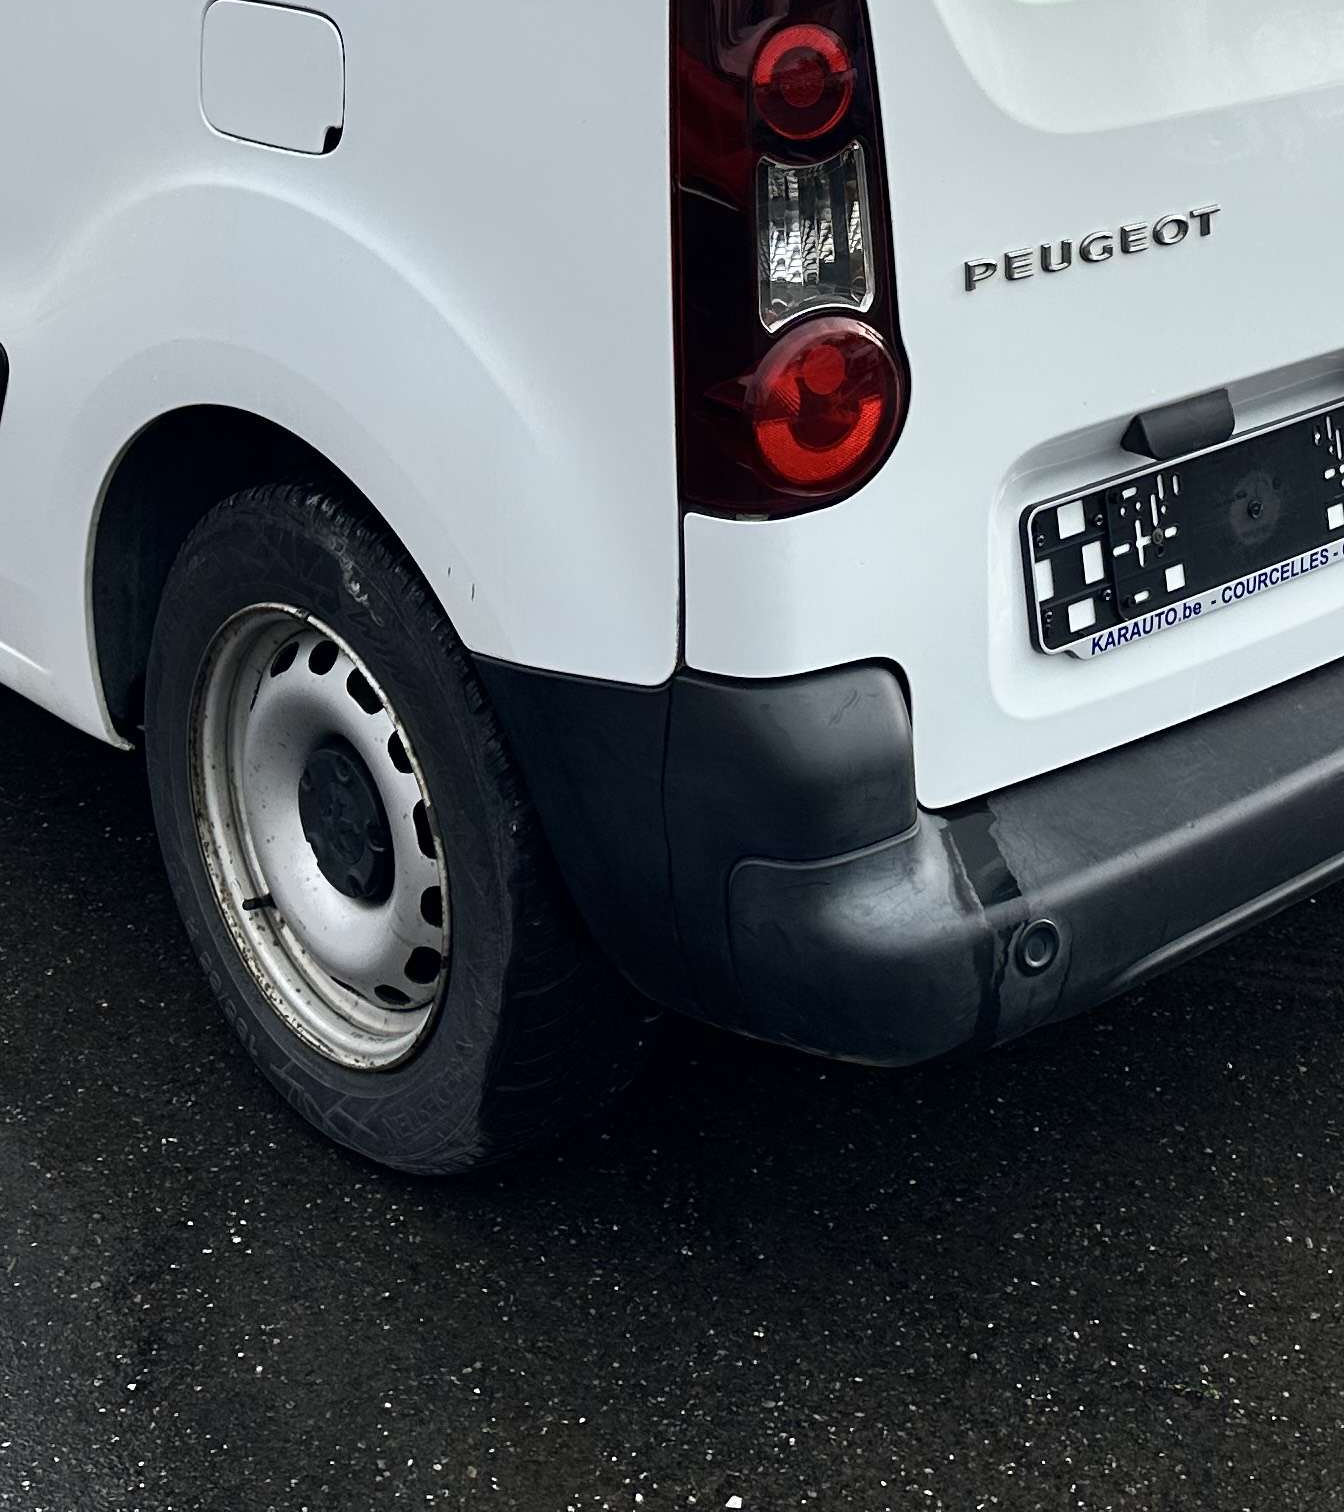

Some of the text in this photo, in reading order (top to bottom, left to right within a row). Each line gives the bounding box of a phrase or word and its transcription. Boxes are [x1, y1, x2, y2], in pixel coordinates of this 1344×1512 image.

[964, 203, 1220, 292] PEUGEOT
[1091, 602, 1202, 656] KARAUTO.be
[1221, 548, 1329, 604] COURCELLES
